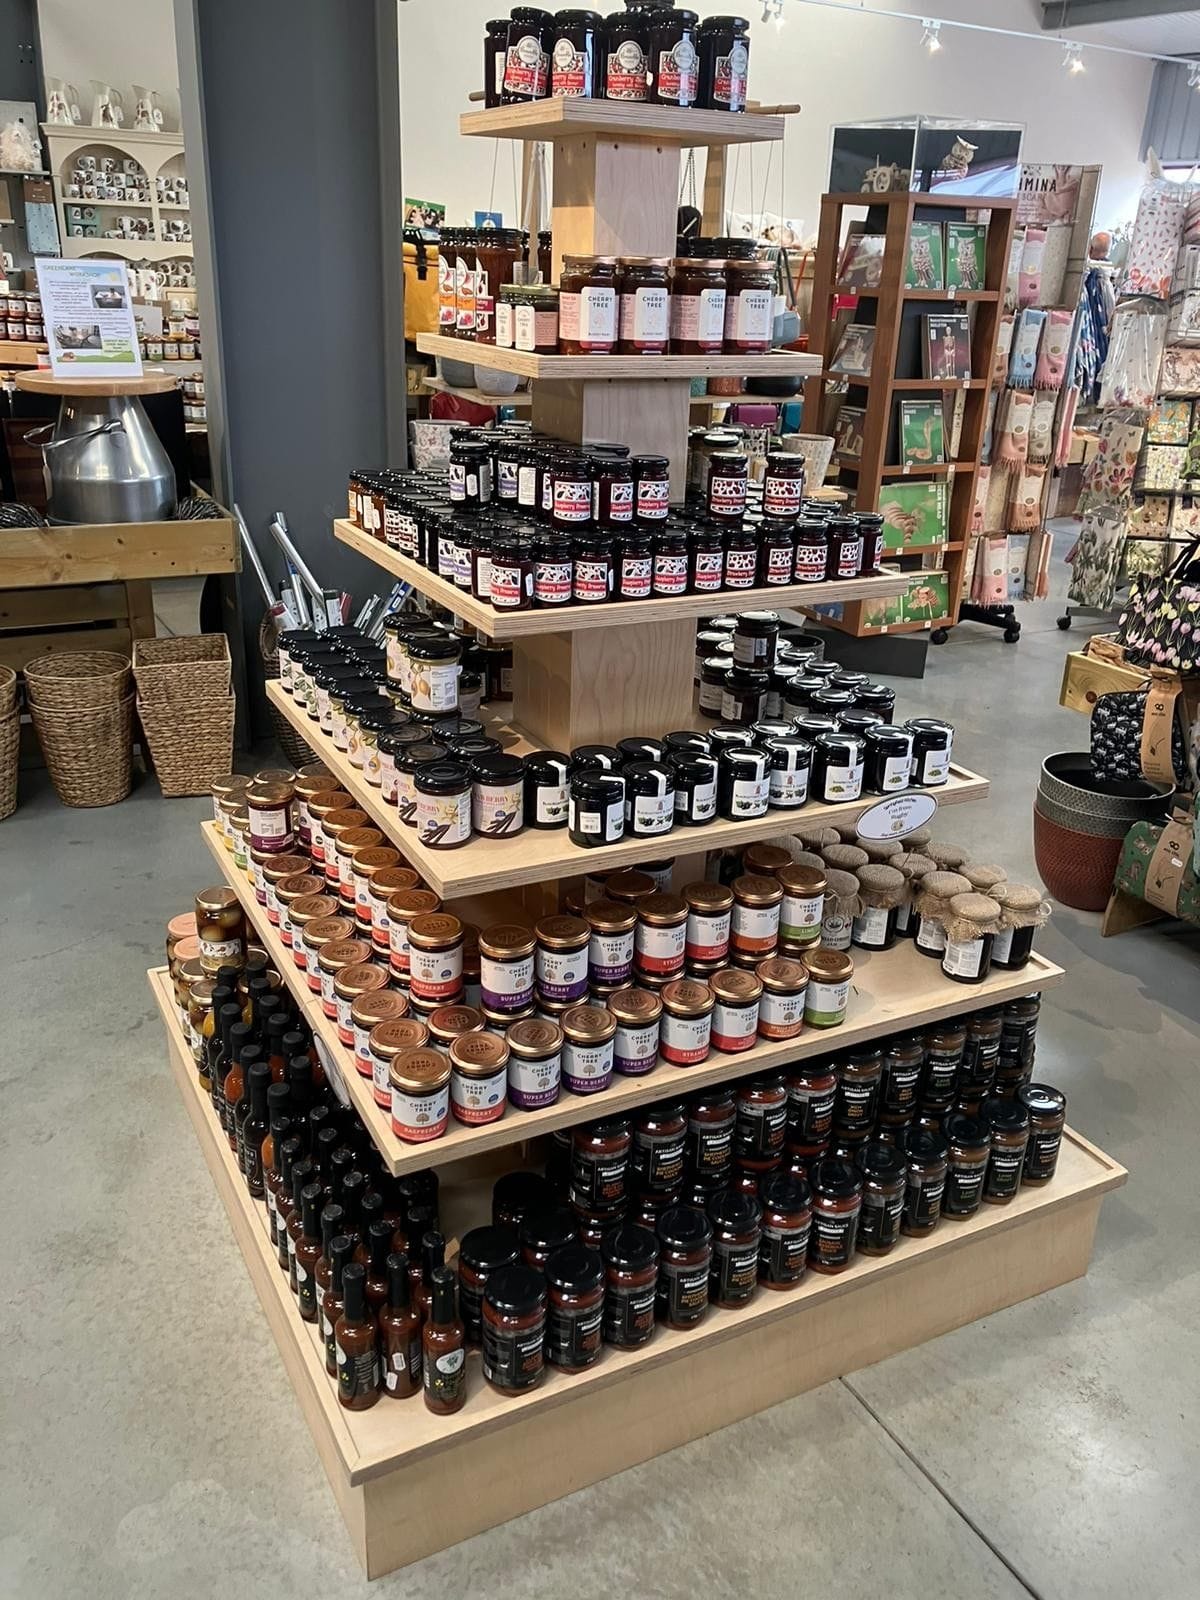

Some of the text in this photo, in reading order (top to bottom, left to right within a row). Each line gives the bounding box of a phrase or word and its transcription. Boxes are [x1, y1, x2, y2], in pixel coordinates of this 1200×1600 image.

[500, 994, 521, 1002] SUPER
[631, 1032, 655, 1041] CHERRY
[532, 1064, 555, 1073] CHERRY
[462, 1084, 488, 1093] CHERRY
[410, 1101, 437, 1109] CHERRY
[404, 1125, 440, 1134] RASPBERRY
